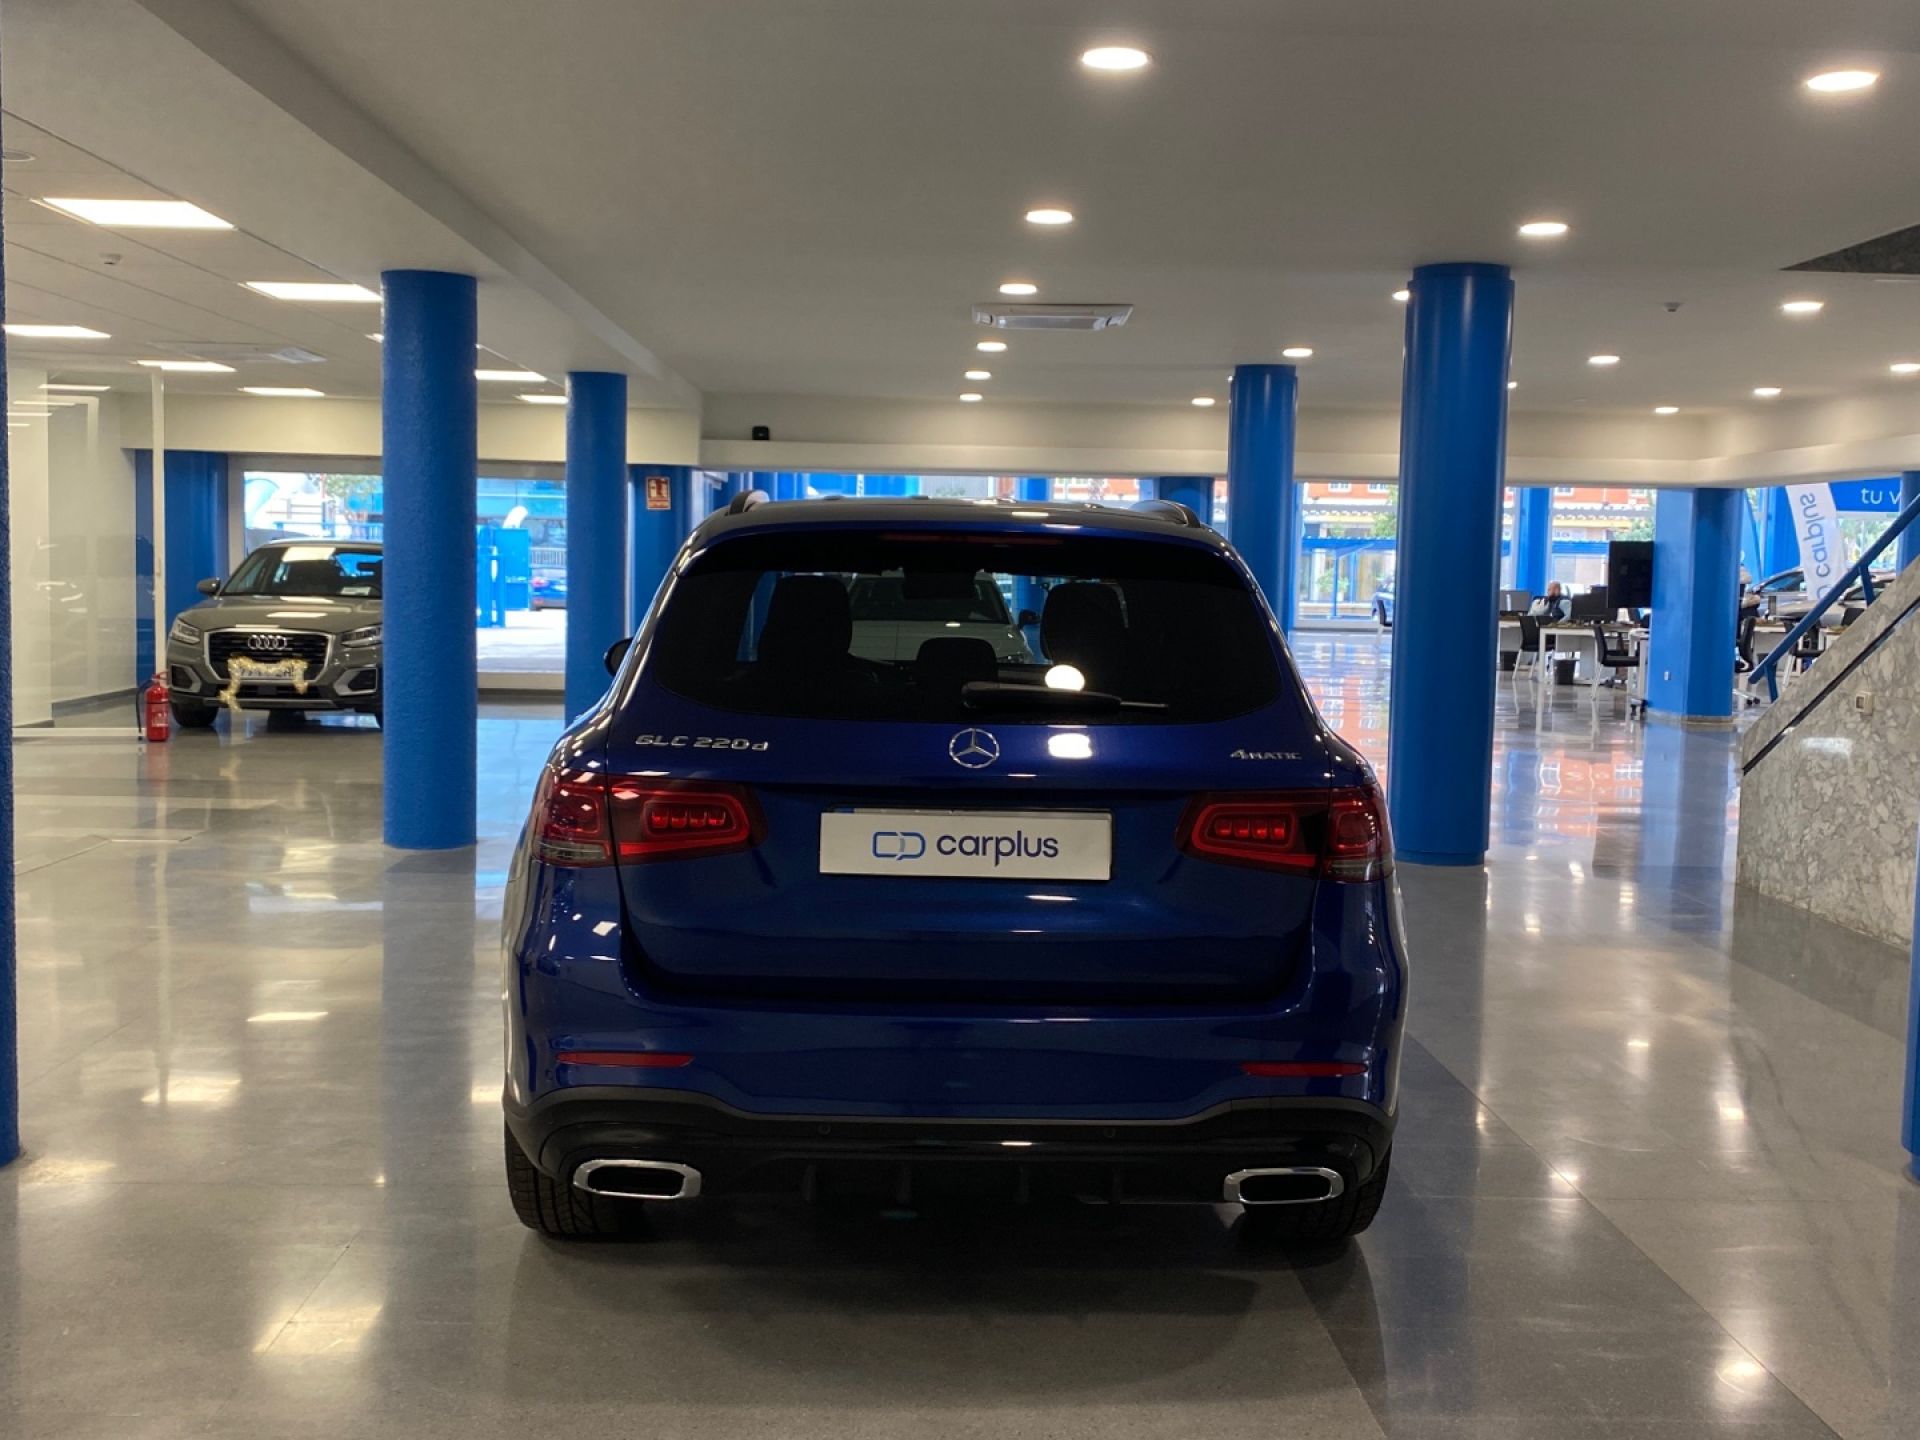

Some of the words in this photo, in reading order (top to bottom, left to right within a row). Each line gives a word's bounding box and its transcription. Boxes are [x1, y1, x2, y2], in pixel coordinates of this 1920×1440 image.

[1861, 488, 1882, 505] tu
[635, 734, 688, 746] GLC
[693, 736, 769, 751] 220d
[1230, 749, 1302, 760] 4MATIC
[936, 830, 1059, 868] carplus
